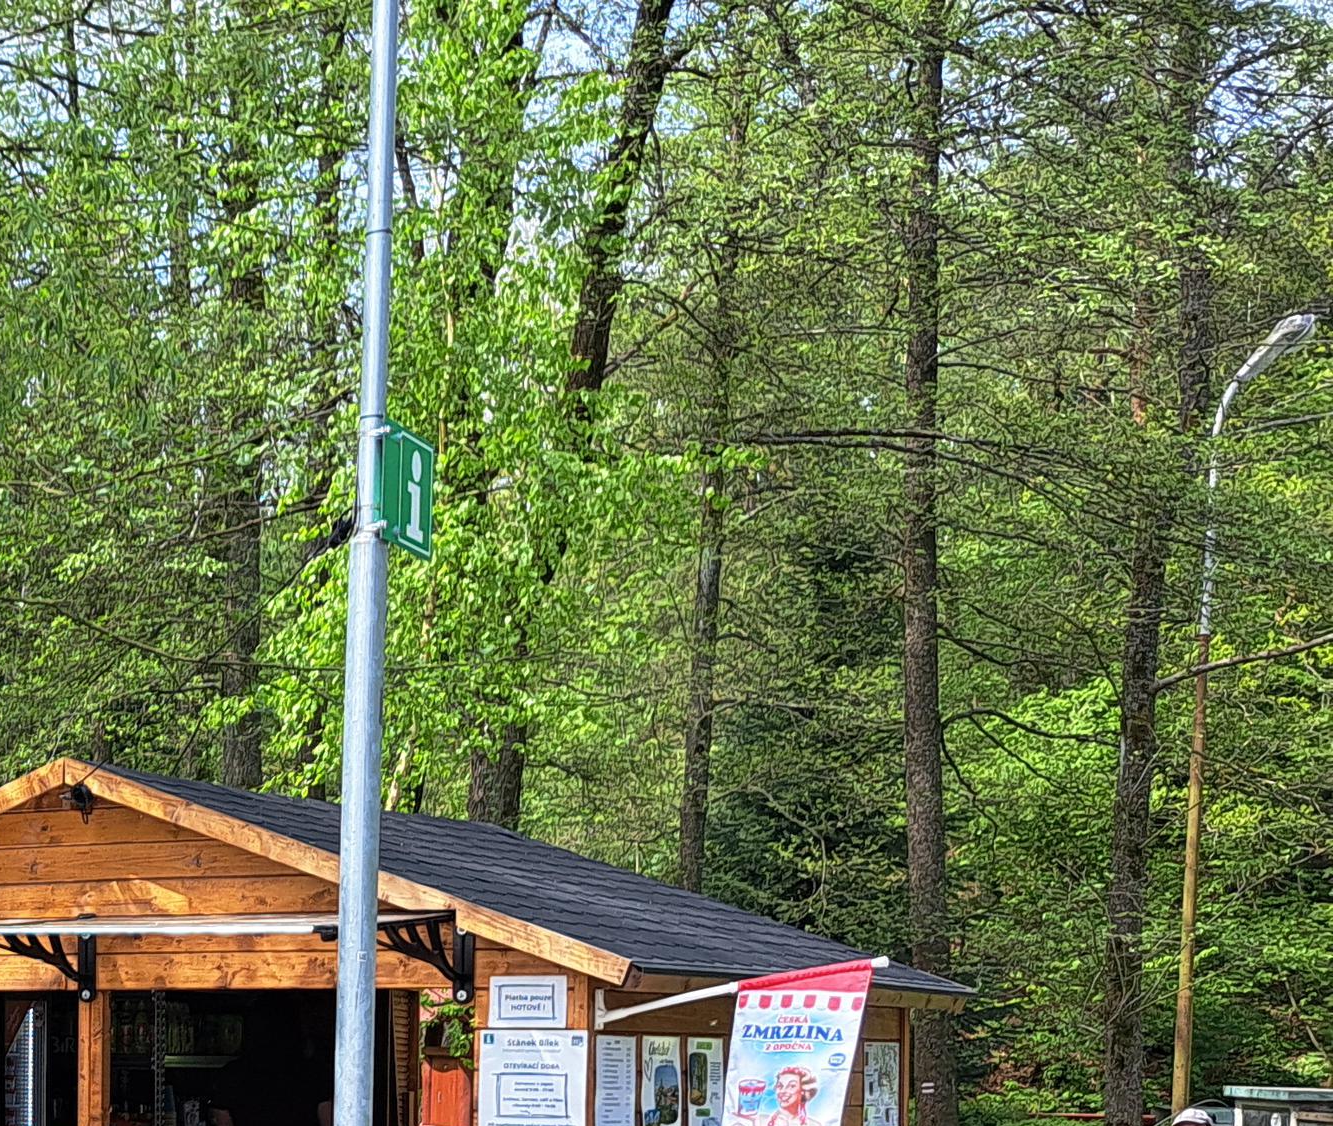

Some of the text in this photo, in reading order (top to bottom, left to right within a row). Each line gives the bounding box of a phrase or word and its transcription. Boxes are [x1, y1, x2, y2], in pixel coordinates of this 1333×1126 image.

[777, 1014, 808, 1023] ČESKÁ
[742, 1024, 844, 1041] ZMRZLINA
[773, 1042, 812, 1050] OPOČNA
